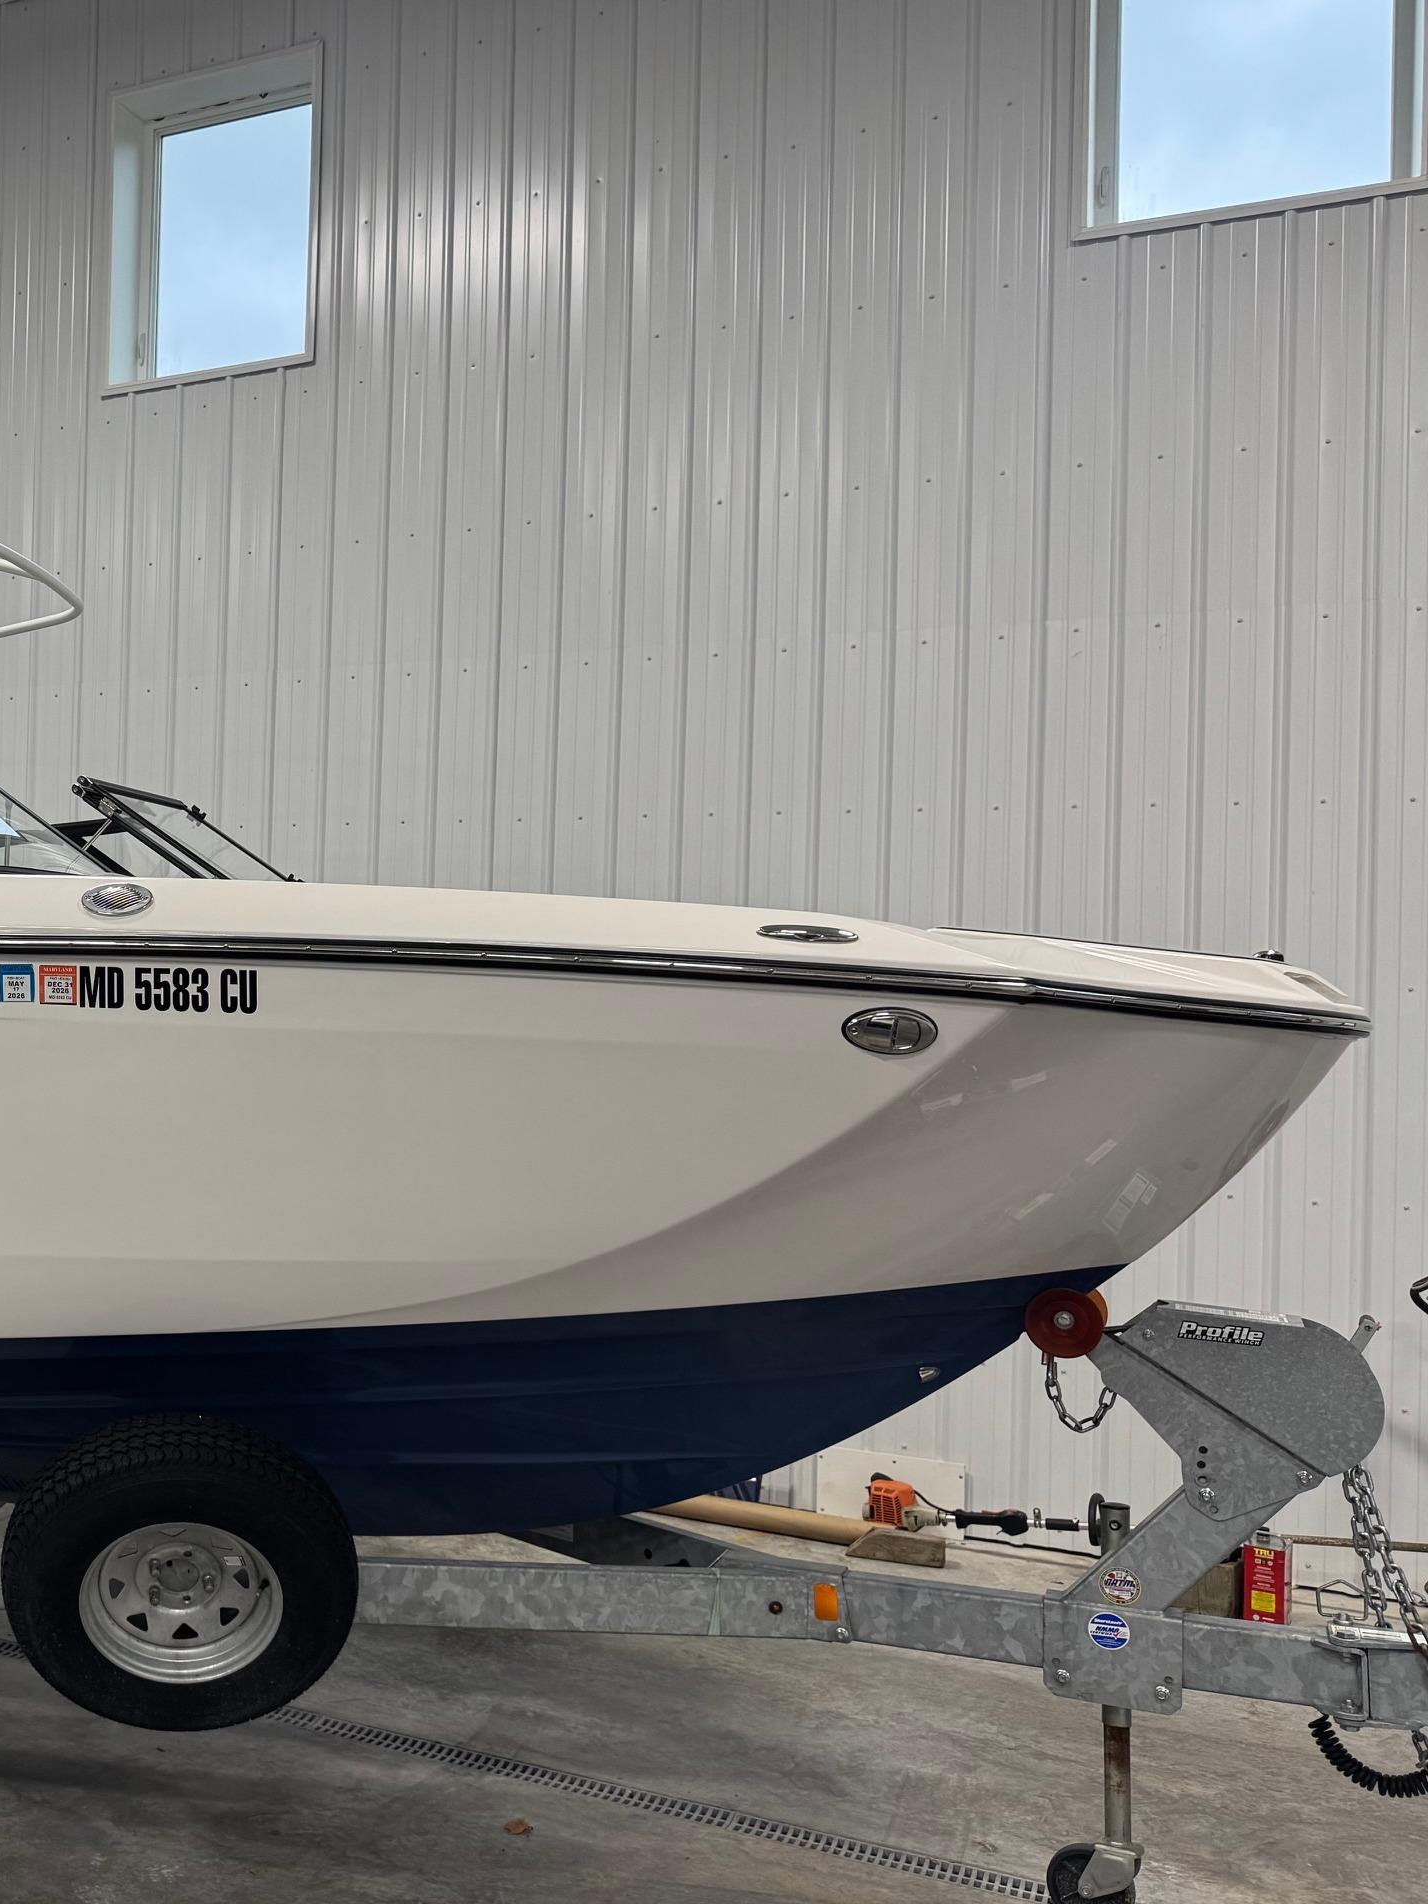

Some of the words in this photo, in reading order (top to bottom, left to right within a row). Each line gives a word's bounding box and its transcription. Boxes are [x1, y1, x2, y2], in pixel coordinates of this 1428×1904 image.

[79, 966, 124, 1008] MD
[134, 967, 209, 1012] 5583
[220, 968, 258, 1014] CU
[1180, 1321, 1264, 1341] Profile
[1179, 1333, 1232, 1343] PERFORMANCE
[1234, 1338, 1260, 1346] WINCH
[1253, 1547, 1275, 1557] TRU
